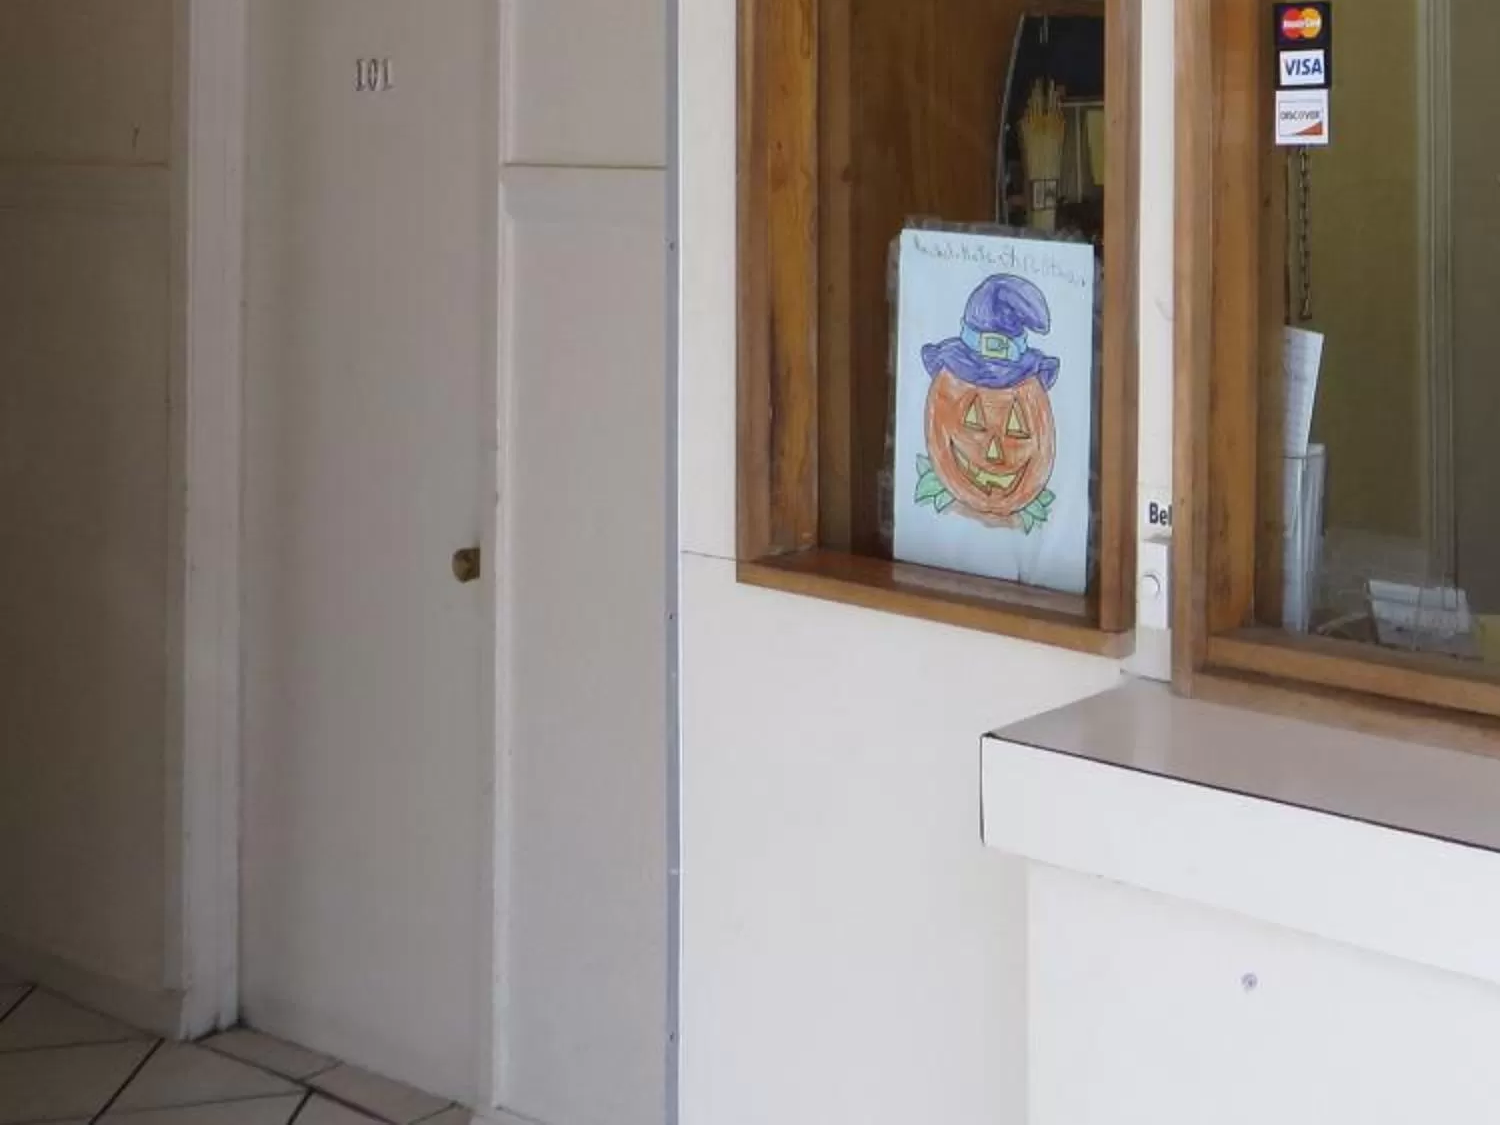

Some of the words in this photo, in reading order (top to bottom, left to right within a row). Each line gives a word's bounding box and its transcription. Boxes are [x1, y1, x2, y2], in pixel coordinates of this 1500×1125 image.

[355, 58, 395, 92] 101
[1284, 58, 1323, 76] VISA
[1280, 110, 1321, 121] DISCOVER
